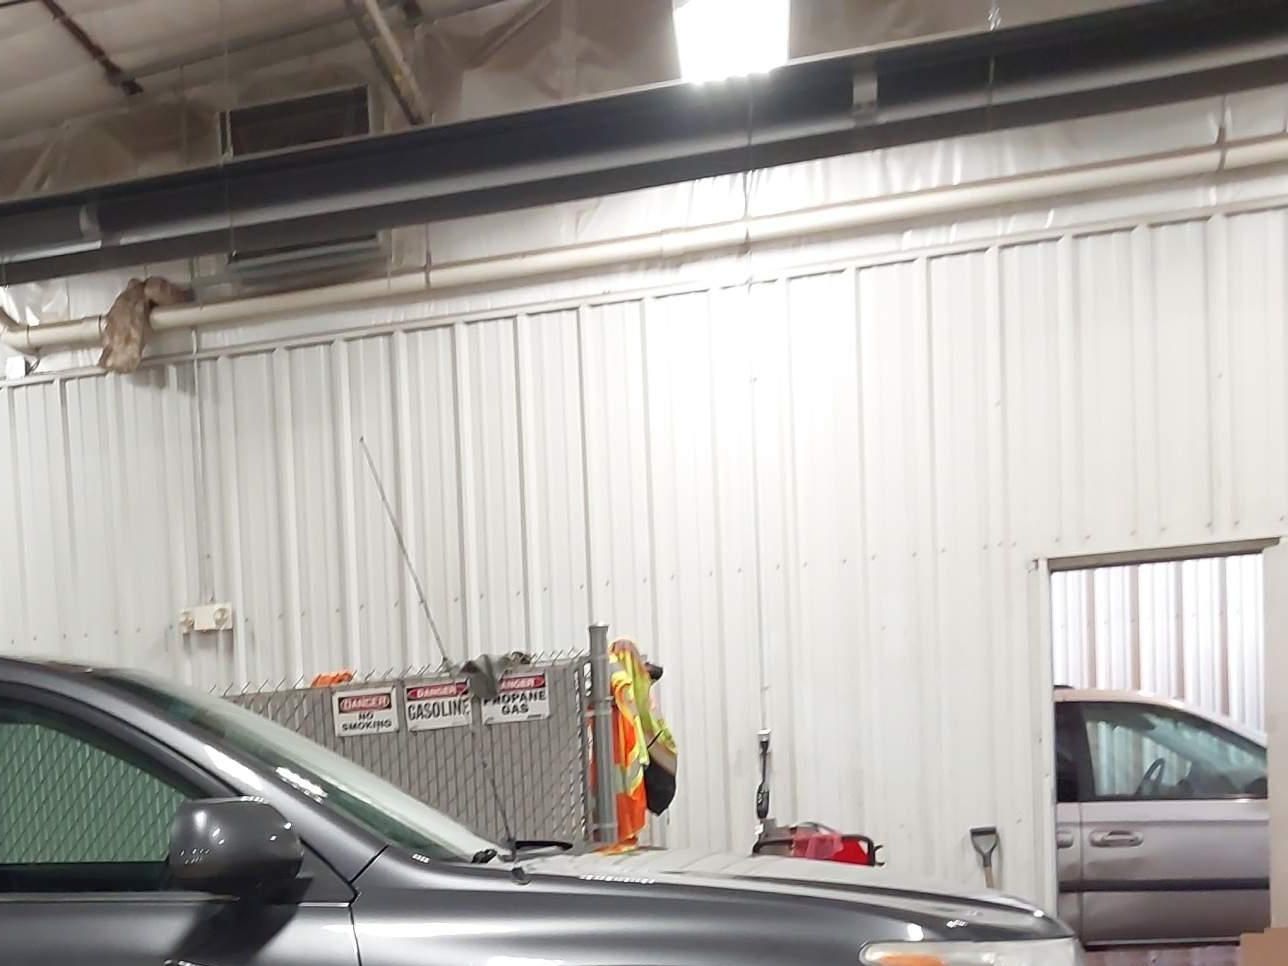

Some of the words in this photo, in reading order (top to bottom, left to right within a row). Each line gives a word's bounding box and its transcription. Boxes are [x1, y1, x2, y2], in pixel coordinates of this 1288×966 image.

[500, 678, 535, 689] ANGER
[415, 686, 457, 698] DANGER
[343, 695, 388, 710] DANGER
[408, 698, 470, 720] GASOLINE
[501, 703, 529, 715] GAS
[358, 712, 374, 721] NO
[342, 719, 392, 731] SMOKING
